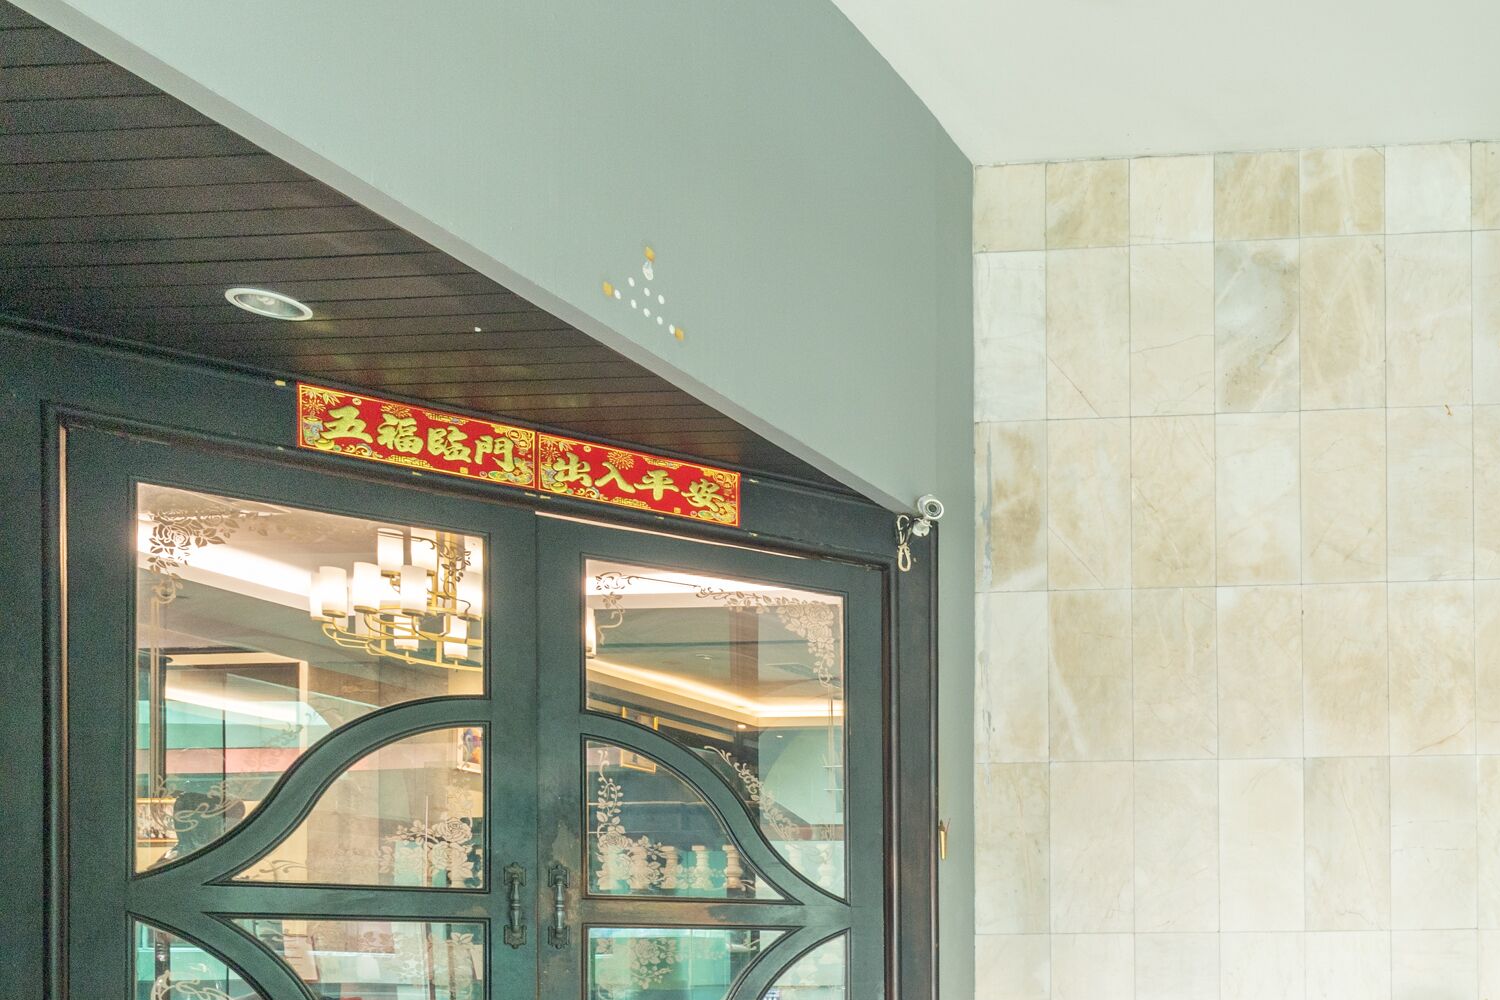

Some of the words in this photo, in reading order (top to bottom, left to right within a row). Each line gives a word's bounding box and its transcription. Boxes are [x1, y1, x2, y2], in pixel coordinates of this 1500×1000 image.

[320, 405, 515, 472] 五福臨門
[553, 452, 724, 512] 出入平安
